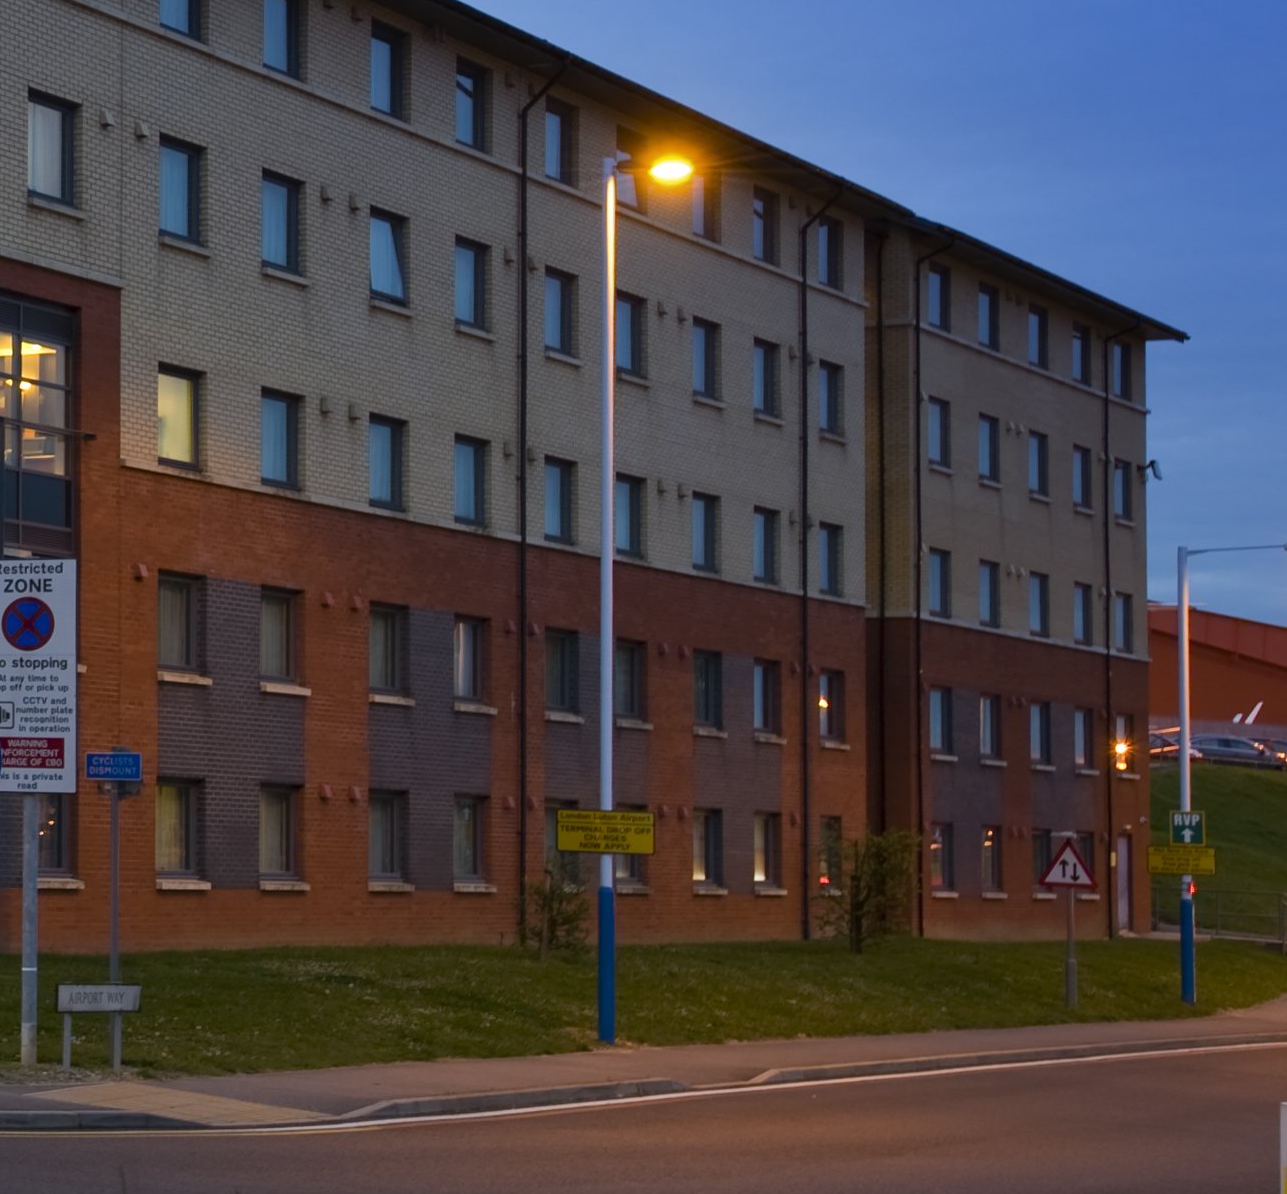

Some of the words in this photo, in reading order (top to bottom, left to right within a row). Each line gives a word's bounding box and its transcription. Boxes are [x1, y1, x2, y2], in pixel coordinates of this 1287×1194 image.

[3, 578, 53, 594] ZONE
[11, 656, 68, 671] stopping
[9, 675, 25, 684] any
[27, 674, 47, 682] time
[49, 674, 59, 682] to
[9, 683, 22, 691] off
[36, 683, 54, 692] pick
[57, 685, 69, 693] up
[22, 696, 48, 704] CCTV
[50, 697, 67, 705] and
[15, 706, 48, 714] number
[50, 706, 74, 715] plate
[19, 716, 69, 724] recognition
[29, 725, 71, 734] operation
[7, 739, 48, 748] WARNING
[0, 748, 59, 757] NFORCEMENT
[30, 757, 43, 766] OF
[92, 756, 134, 766] CYCLISTS
[89, 765, 137, 775] DISMOUNT
[12, 771, 21, 780] is
[31, 771, 63, 781] private
[17, 781, 38, 790] road
[1173, 813, 1200, 826] RVP
[68, 992, 103, 1005] AIRPORT
[107, 992, 125, 1005] WAY
